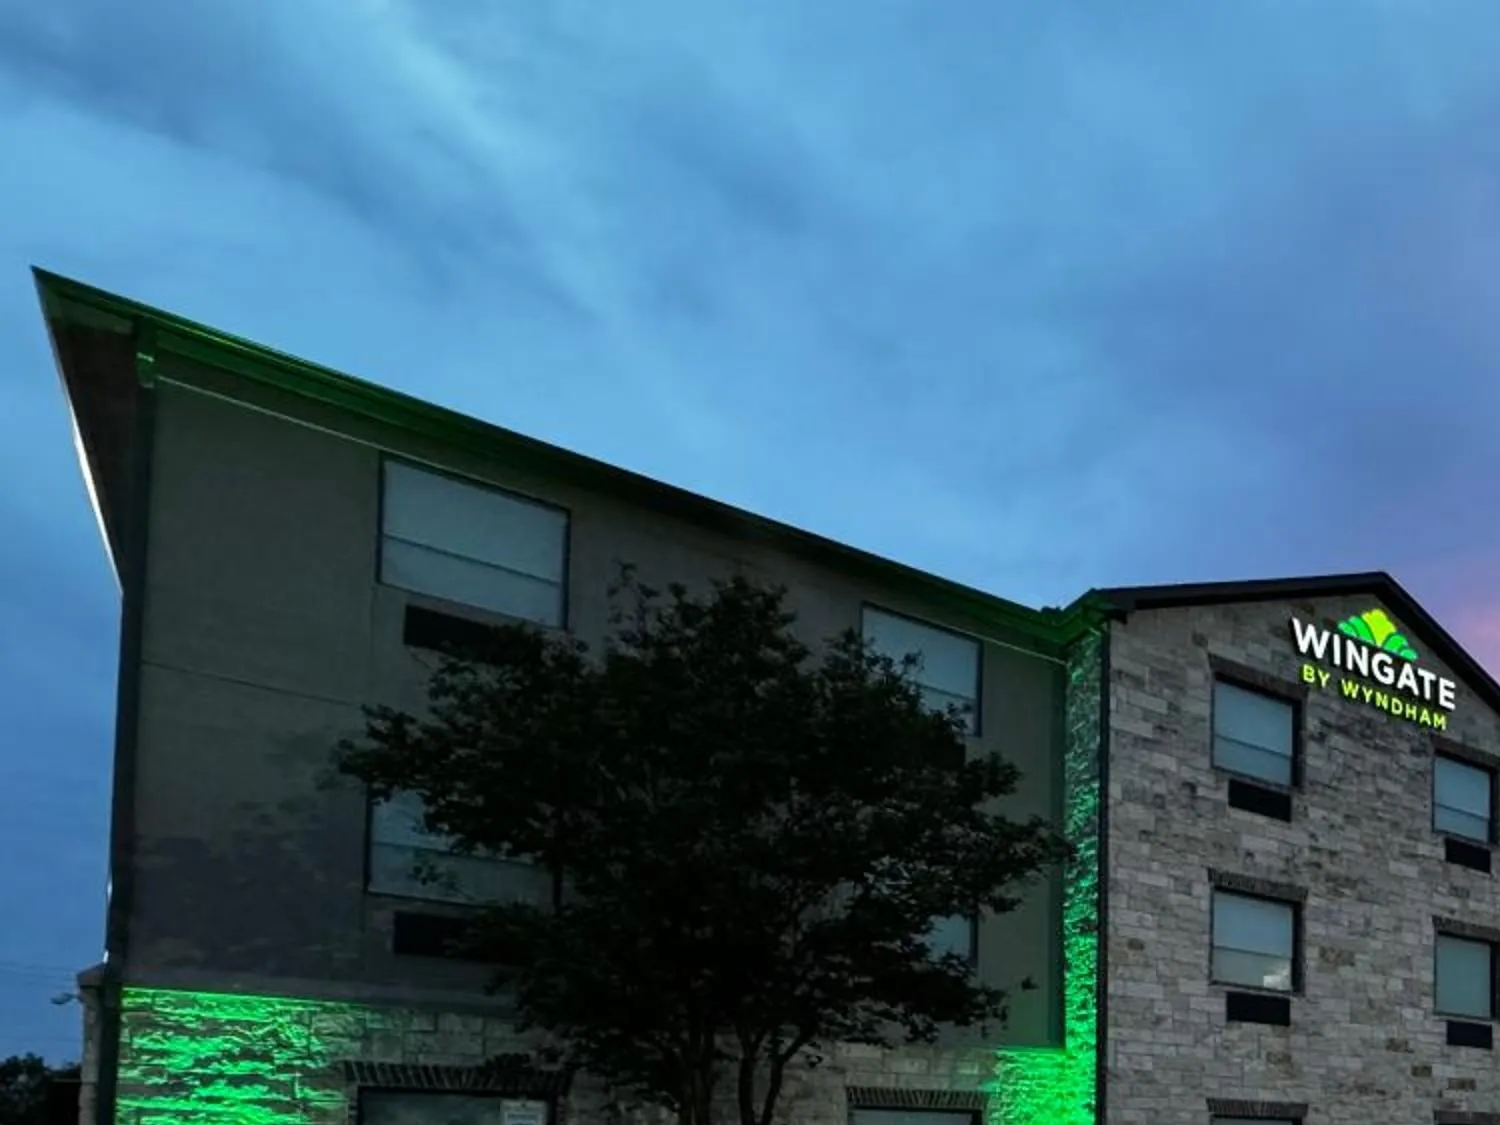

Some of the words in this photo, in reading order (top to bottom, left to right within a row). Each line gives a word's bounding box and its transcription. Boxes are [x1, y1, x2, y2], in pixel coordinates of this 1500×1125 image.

[1292, 617, 1456, 710] WINGATE
[1302, 663, 1330, 688] BY
[1341, 678, 1447, 731] WYNDHAM
